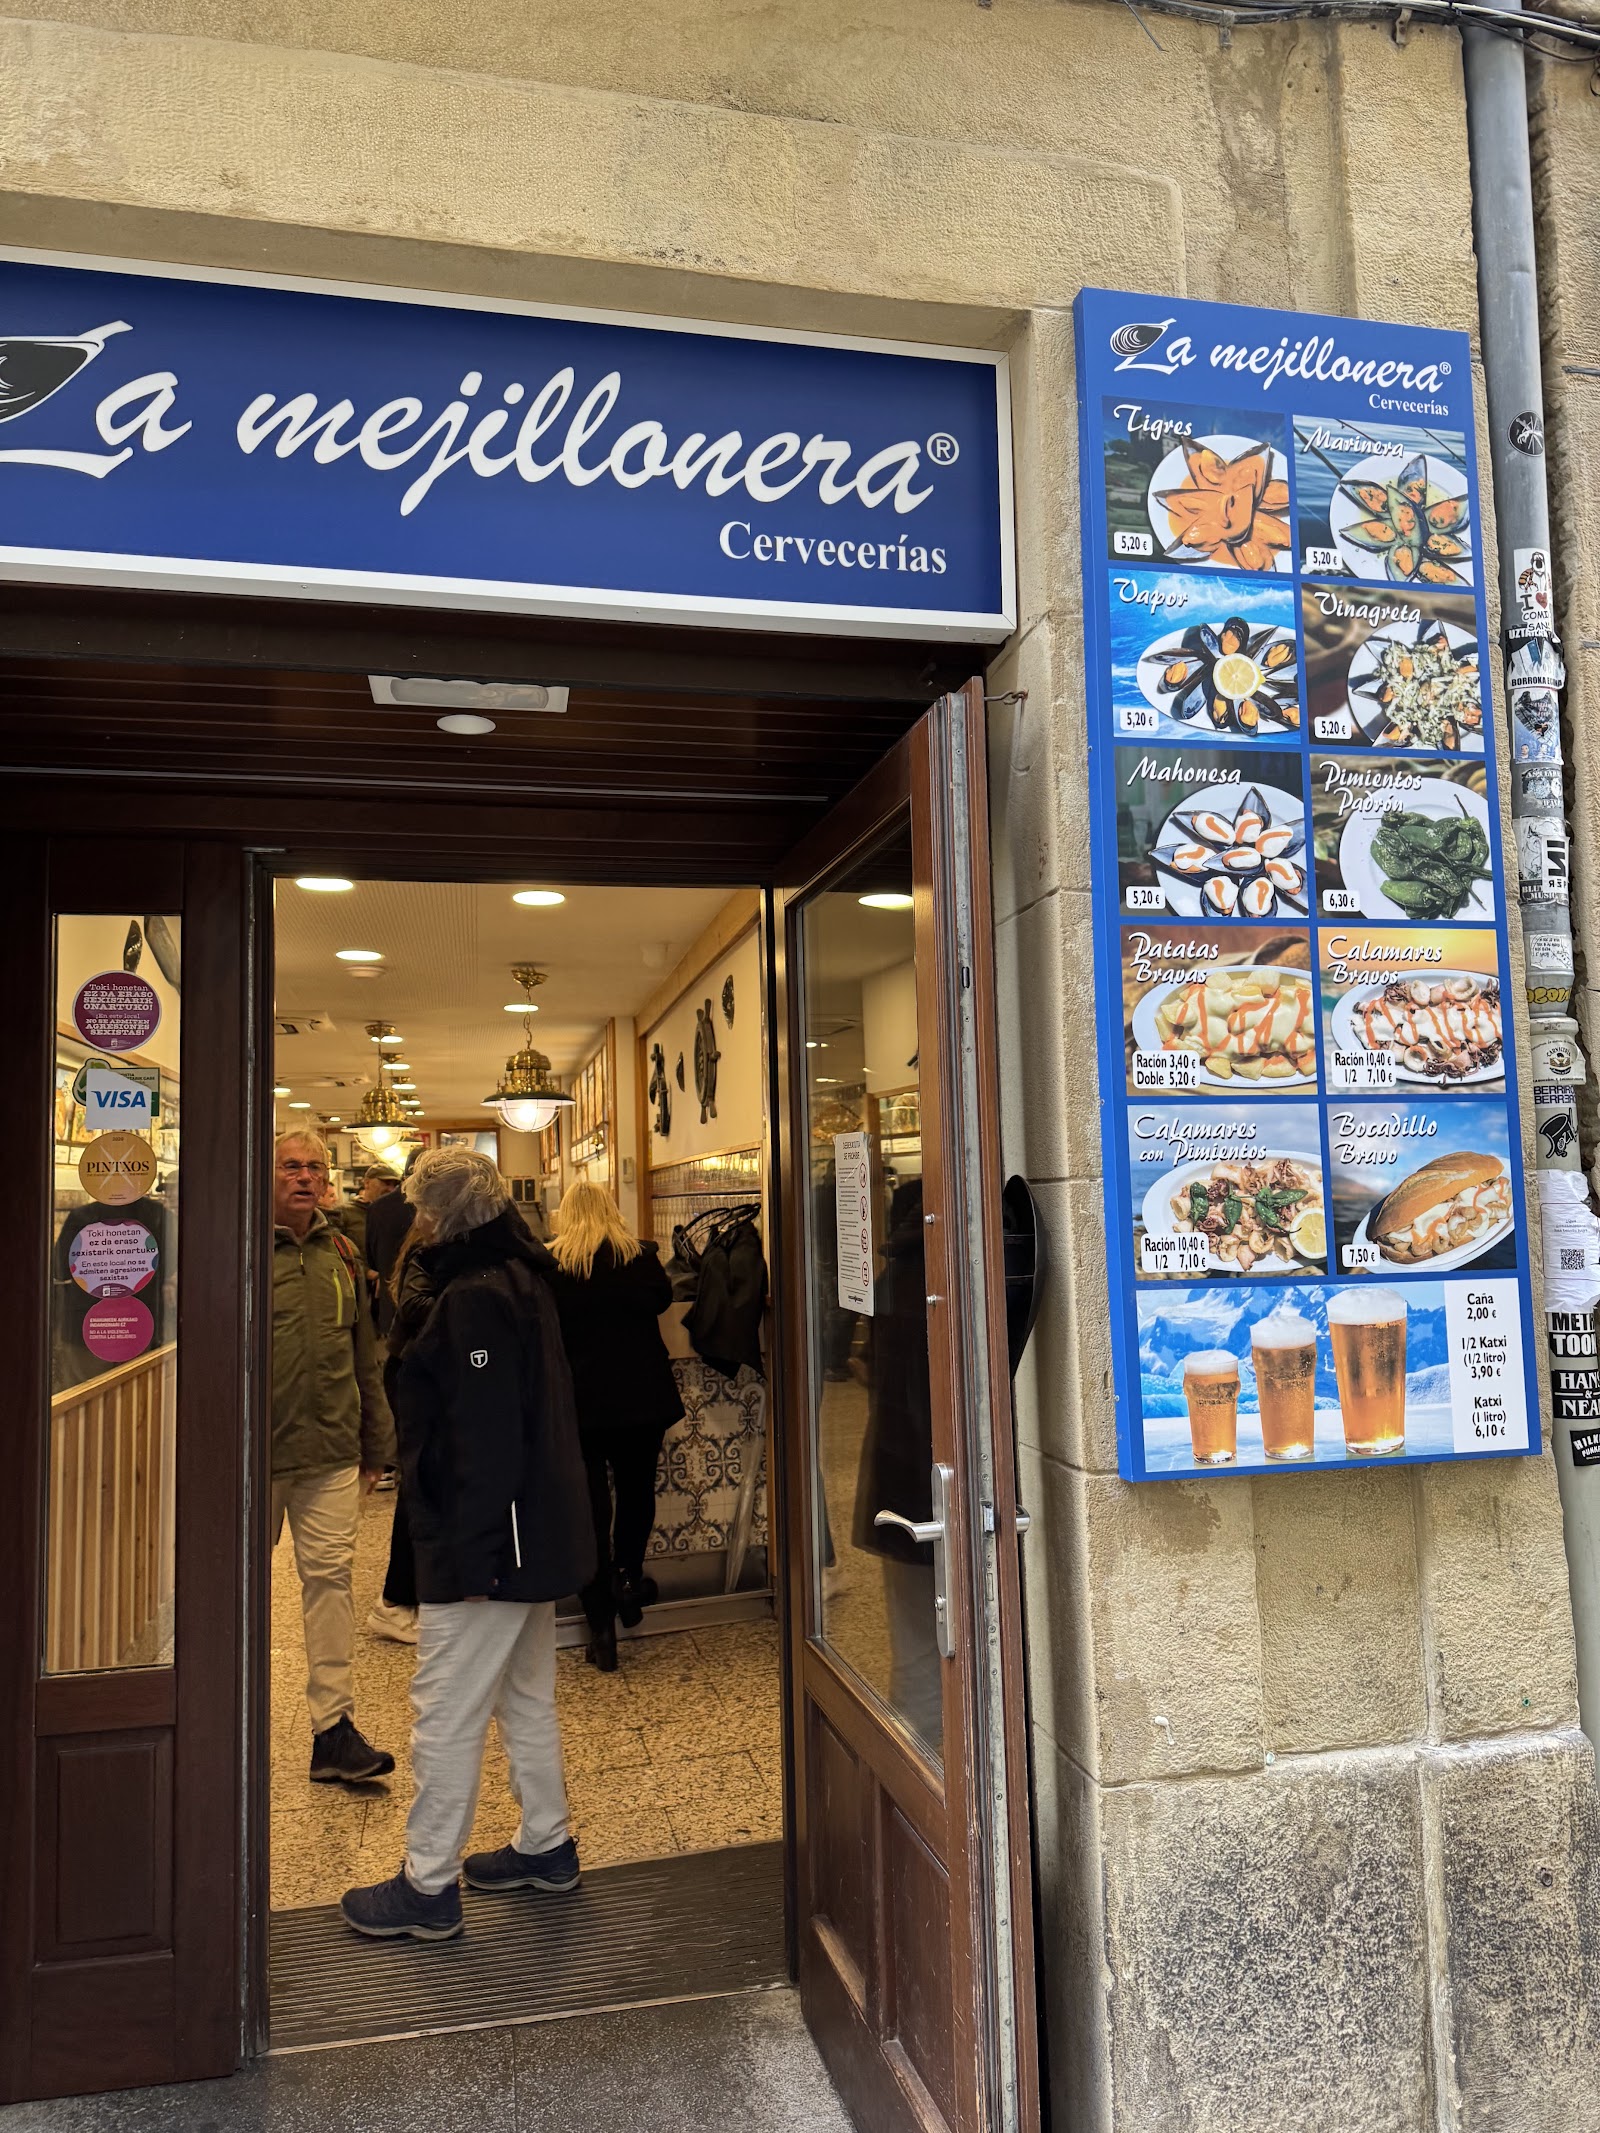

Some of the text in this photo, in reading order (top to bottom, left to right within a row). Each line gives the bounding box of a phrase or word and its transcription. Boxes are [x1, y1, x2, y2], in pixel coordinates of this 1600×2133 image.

[1368, 394, 1449, 416] Cervecerías
[1113, 404, 1193, 440] Tigres
[1303, 426, 1404, 457] Marinera
[719, 520, 947, 575] Cervecerías
[1121, 536, 1141, 551] 5,20
[1313, 551, 1331, 566] 5,20
[1113, 578, 1189, 615] Vapor
[1520, 594, 1534, 611] I
[1314, 592, 1421, 625] Vinagreta
[1528, 621, 1551, 632] SAN
[1126, 711, 1146, 727] 5,20
[1321, 721, 1340, 737] 5,20
[1126, 756, 1242, 786] Mahonesa
[1319, 760, 1422, 791] Pimientos
[1333, 787, 1404, 816] Padrón
[1133, 890, 1153, 906] 5,20
[1329, 893, 1348, 909] 6,30
[1128, 932, 1218, 964] Patatas
[1327, 935, 1442, 961] Calamares
[1130, 961, 1207, 984] Bravas
[1327, 962, 1398, 985] Bravos
[1136, 1053, 1167, 1068] Ración
[1170, 1054, 1189, 1070] 3,40
[1335, 1052, 1364, 1067] Ración
[1366, 1052, 1385, 1068] 10,40
[1137, 1071, 1164, 1086] Doble
[1169, 1071, 1189, 1087] 5,20
[1345, 1069, 1357, 1083] 1/2
[1367, 1069, 1386, 1084] 7,10
[91, 1090, 147, 1108] VISA
[1134, 1114, 1257, 1140] Calamares
[1332, 1112, 1438, 1138] Bocadillo
[1140, 1138, 1266, 1166] con Pimientos
[1334, 1141, 1398, 1164] Bravo
[86, 1160, 149, 1173] PINTXOS
[106, 1229, 141, 1237] honetan
[71, 1247, 156, 1256] sexistarik onartuko
[1145, 1237, 1176, 1252] Ración
[1178, 1237, 1198, 1253] 10,40
[1155, 1255, 1168, 1269] 1/2
[1179, 1254, 1199, 1270] 7,10
[1349, 1249, 1369, 1264] 7,50
[1467, 1293, 1494, 1305] Caña
[1467, 1307, 1489, 1322] 2,00
[1461, 1335, 1507, 1351] 1/2 Katxi
[1463, 1351, 1506, 1367] (1/2 litro)
[1471, 1366, 1493, 1380] 3,90
[1474, 1394, 1502, 1409] Katxi
[1585, 1390, 1593, 1399] &
[1562, 1400, 1600, 1417] NEA
[1472, 1410, 1507, 1426] (1 litro)
[1475, 1424, 1498, 1439] 6,10
